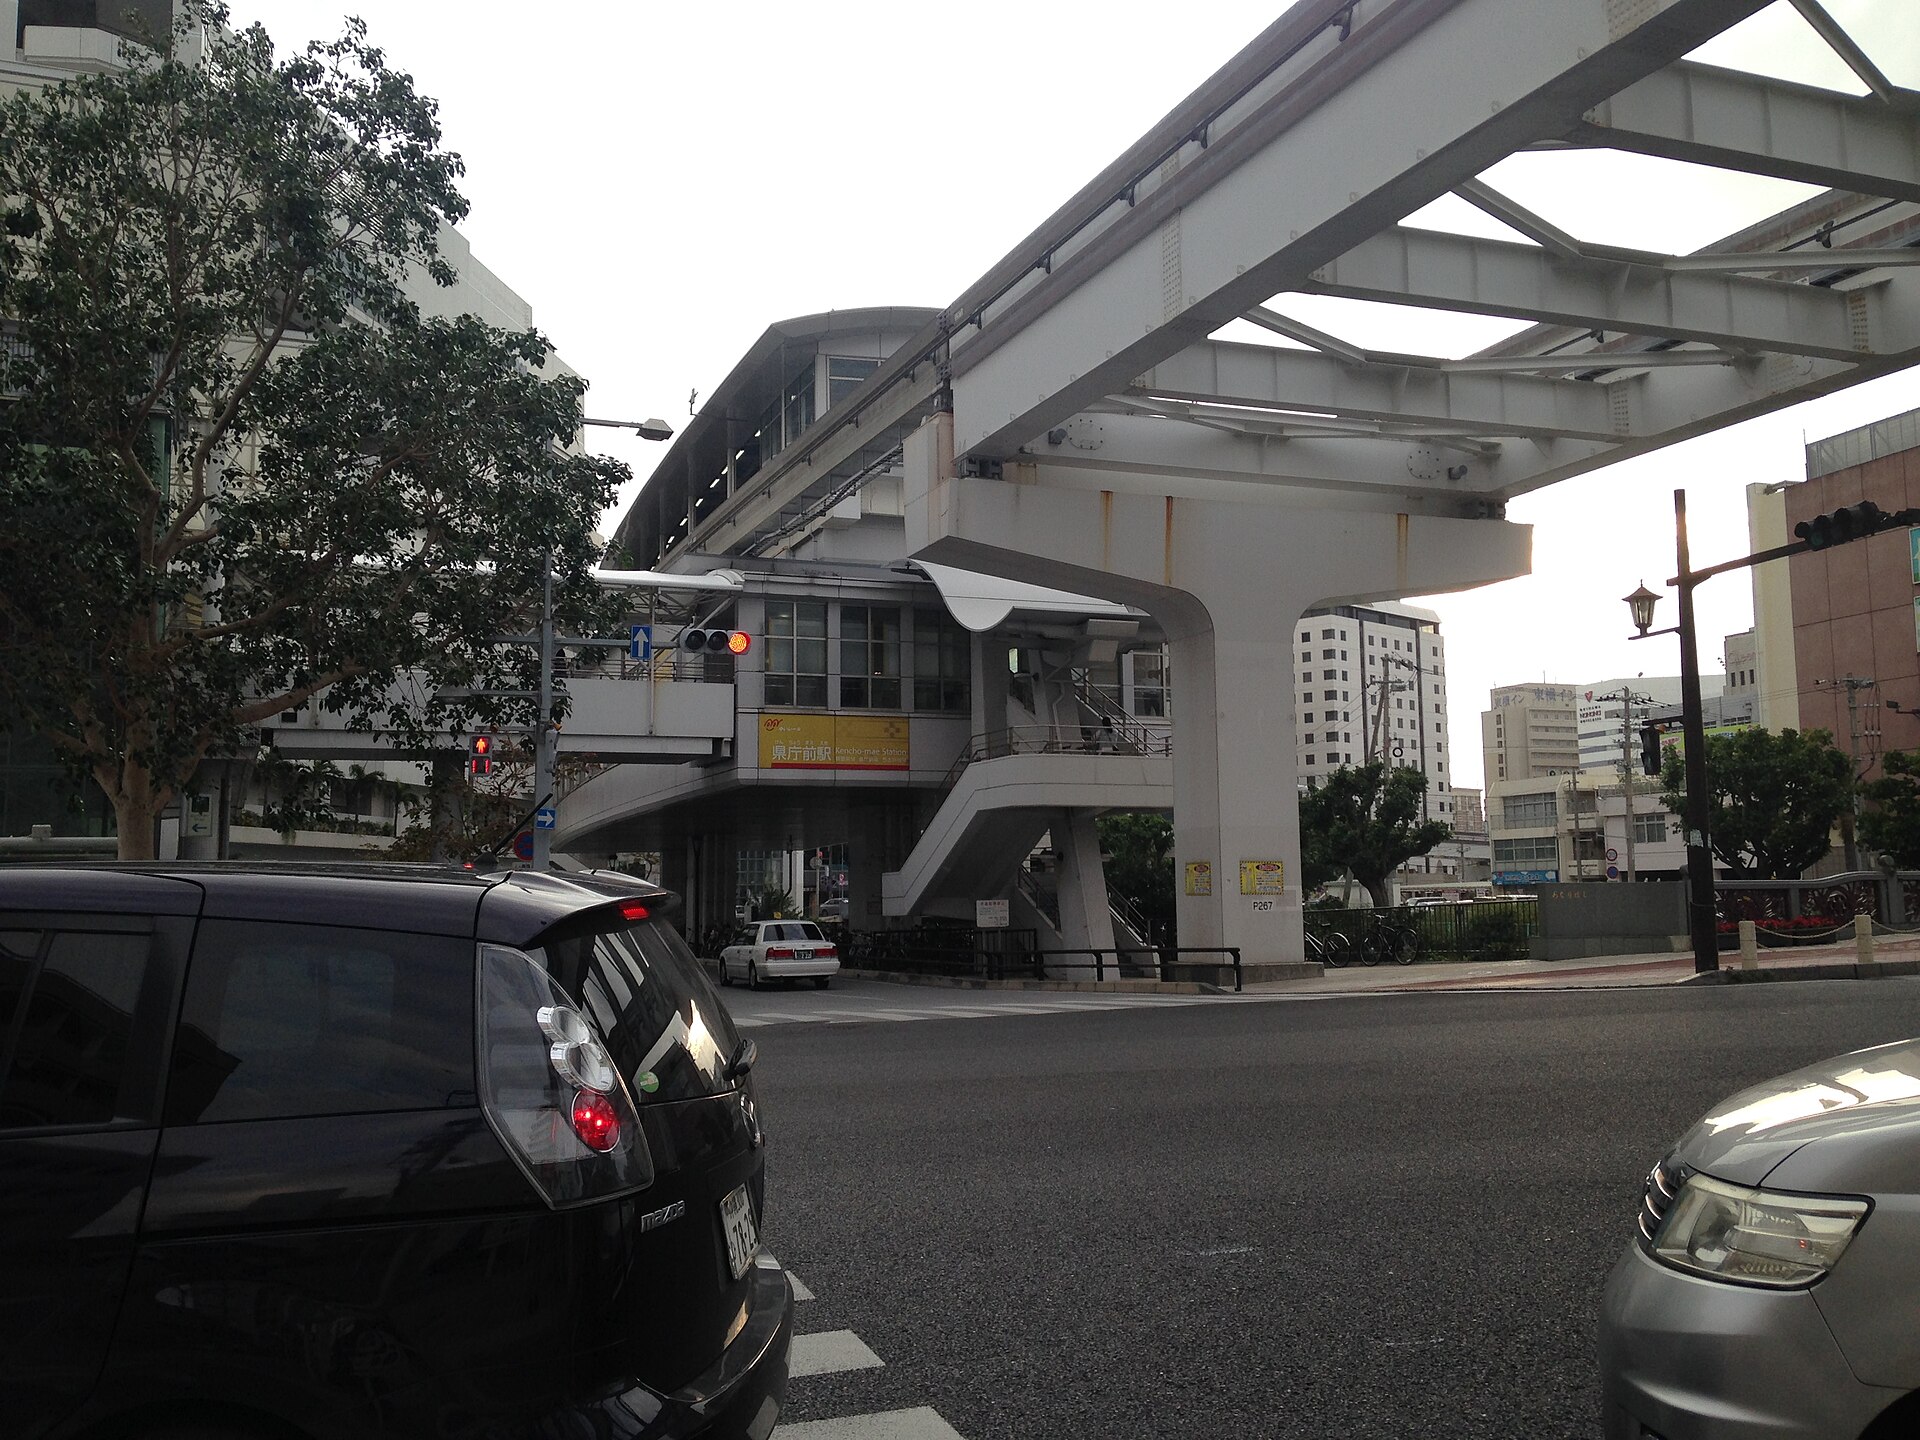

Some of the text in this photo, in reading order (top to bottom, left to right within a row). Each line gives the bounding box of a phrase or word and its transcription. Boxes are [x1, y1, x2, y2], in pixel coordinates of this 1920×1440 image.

[772, 745, 832, 761] 県庁前駅
[835, 746, 907, 756] Kencho-mae Station
[1253, 901, 1273, 911] P267
